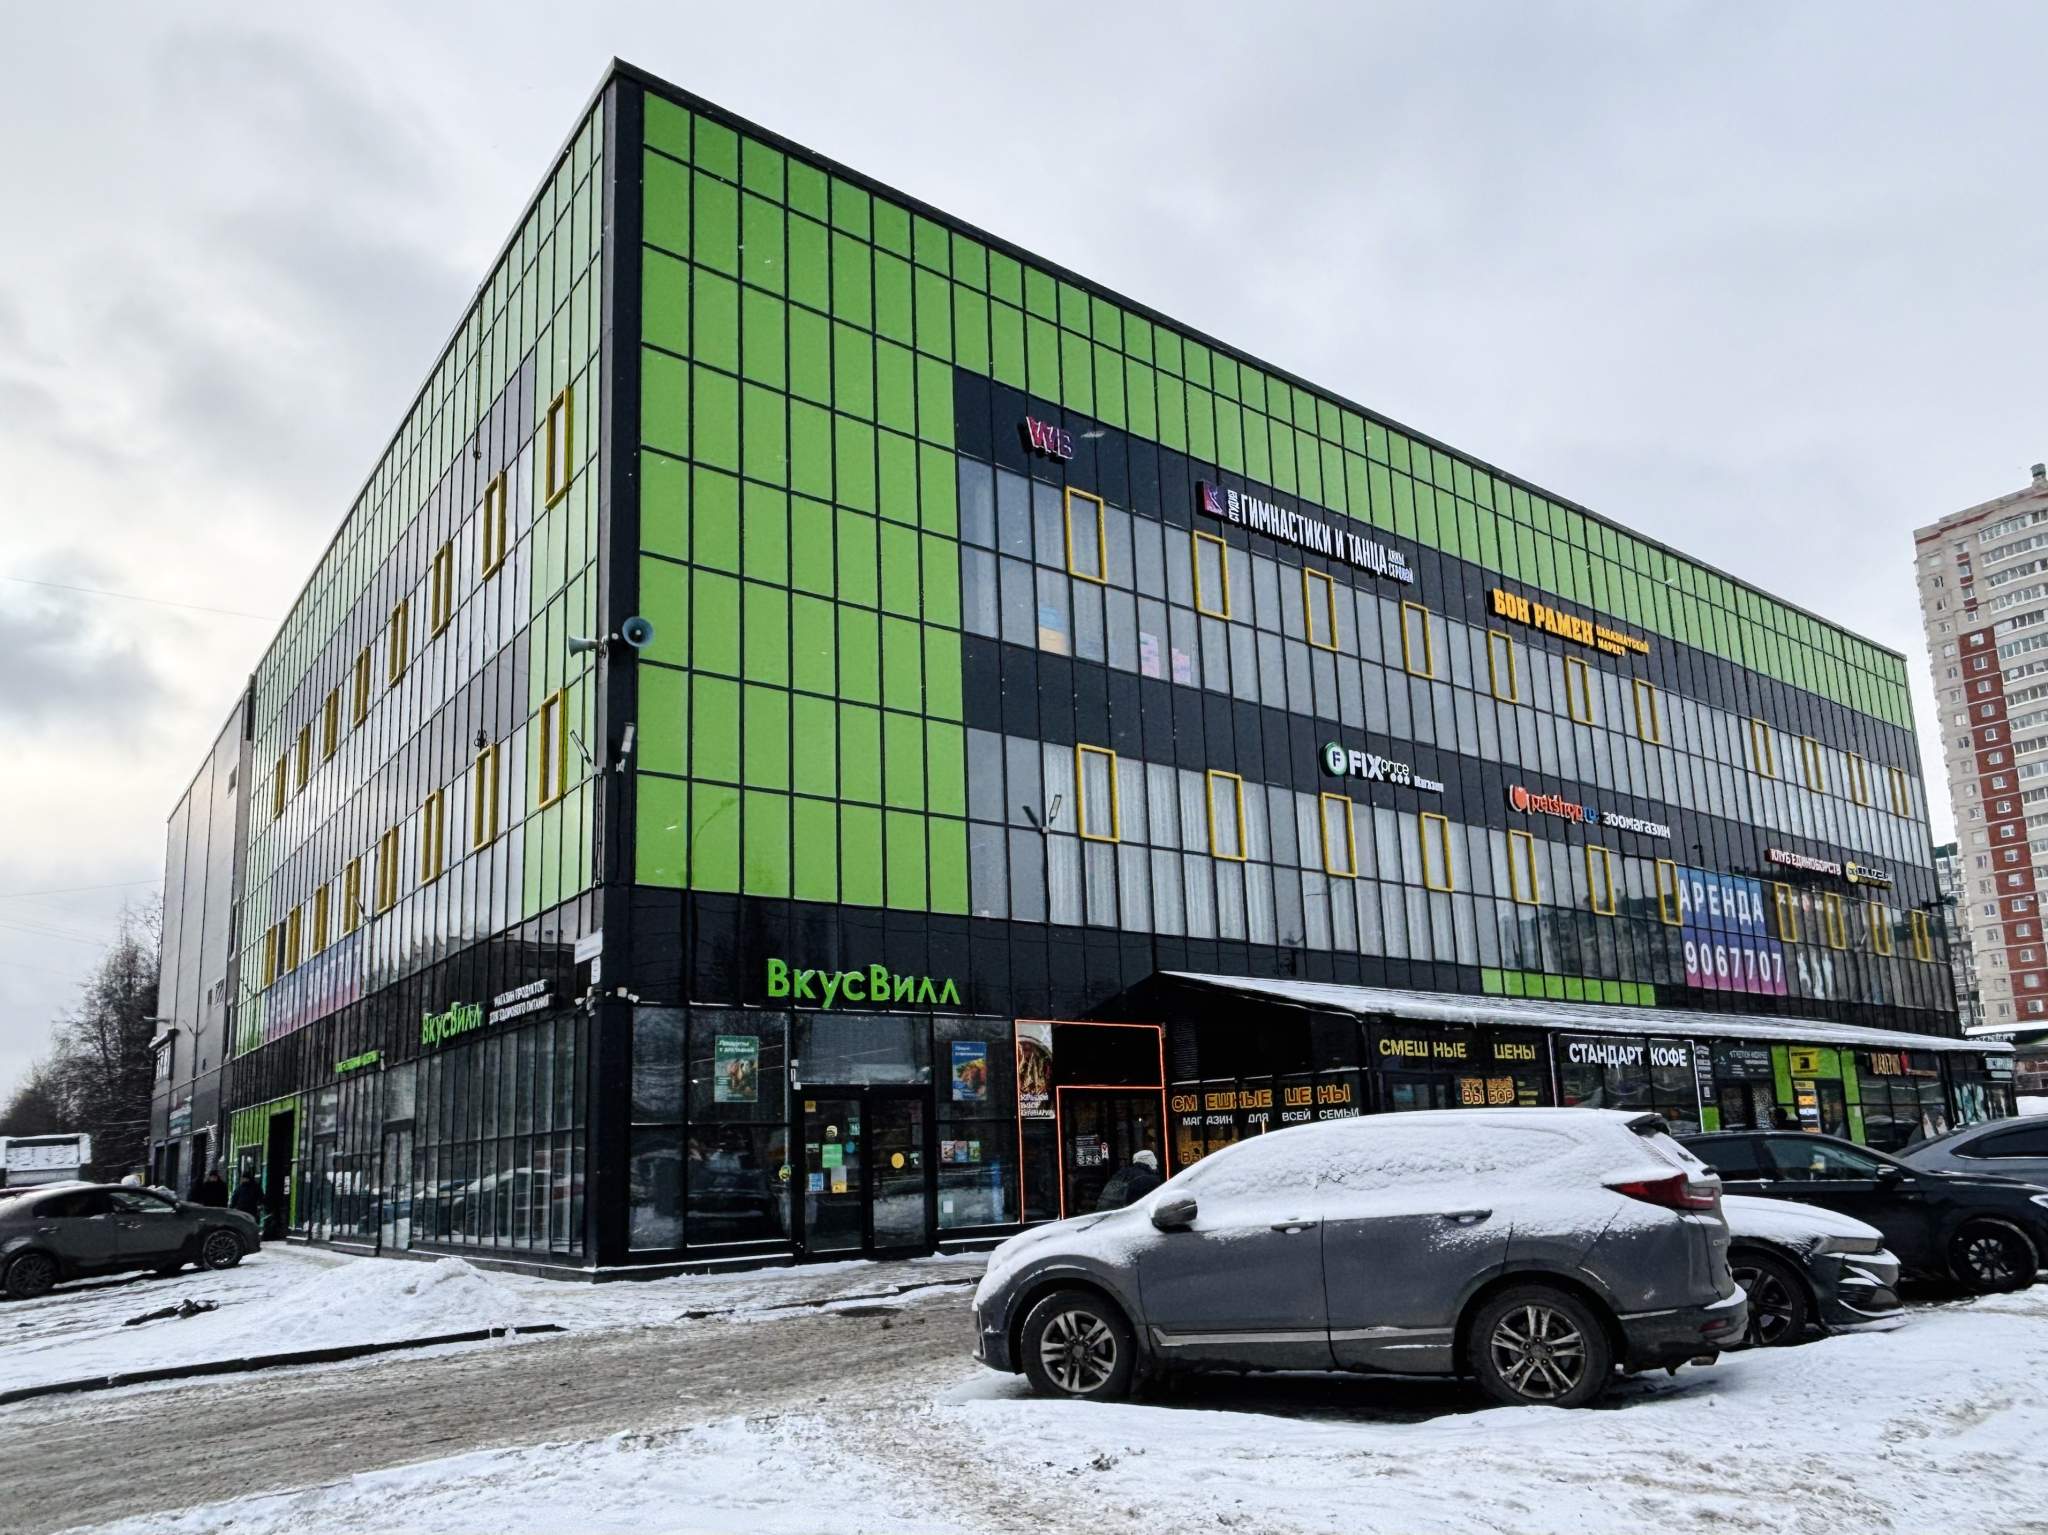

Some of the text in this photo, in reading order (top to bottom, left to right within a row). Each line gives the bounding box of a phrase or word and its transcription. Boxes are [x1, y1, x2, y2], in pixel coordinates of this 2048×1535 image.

[1026, 416, 1073, 459] WB
[1240, 494, 1388, 576] ГИМНАСТИКИ И ТАНЦА
[1492, 587, 1595, 646] БОН РАМЕН
[1679, 879, 1765, 926] АРЕНДА
[767, 958, 961, 1009] ВкусВилл
[1685, 941, 1782, 984] 9067707
[422, 1001, 481, 1048] ВкусВилл
[1493, 1043, 1536, 1060] ЦЕНЫ
[1568, 1043, 1644, 1069] СТАНДАРТ
[1650, 1047, 1688, 1067] КОФЕ
[1248, 1112, 1269, 1124] ДЛЯ
[1282, 1108, 1311, 1122] ВСЕЙ
[1318, 1107, 1360, 1120] СЕМЬИ
